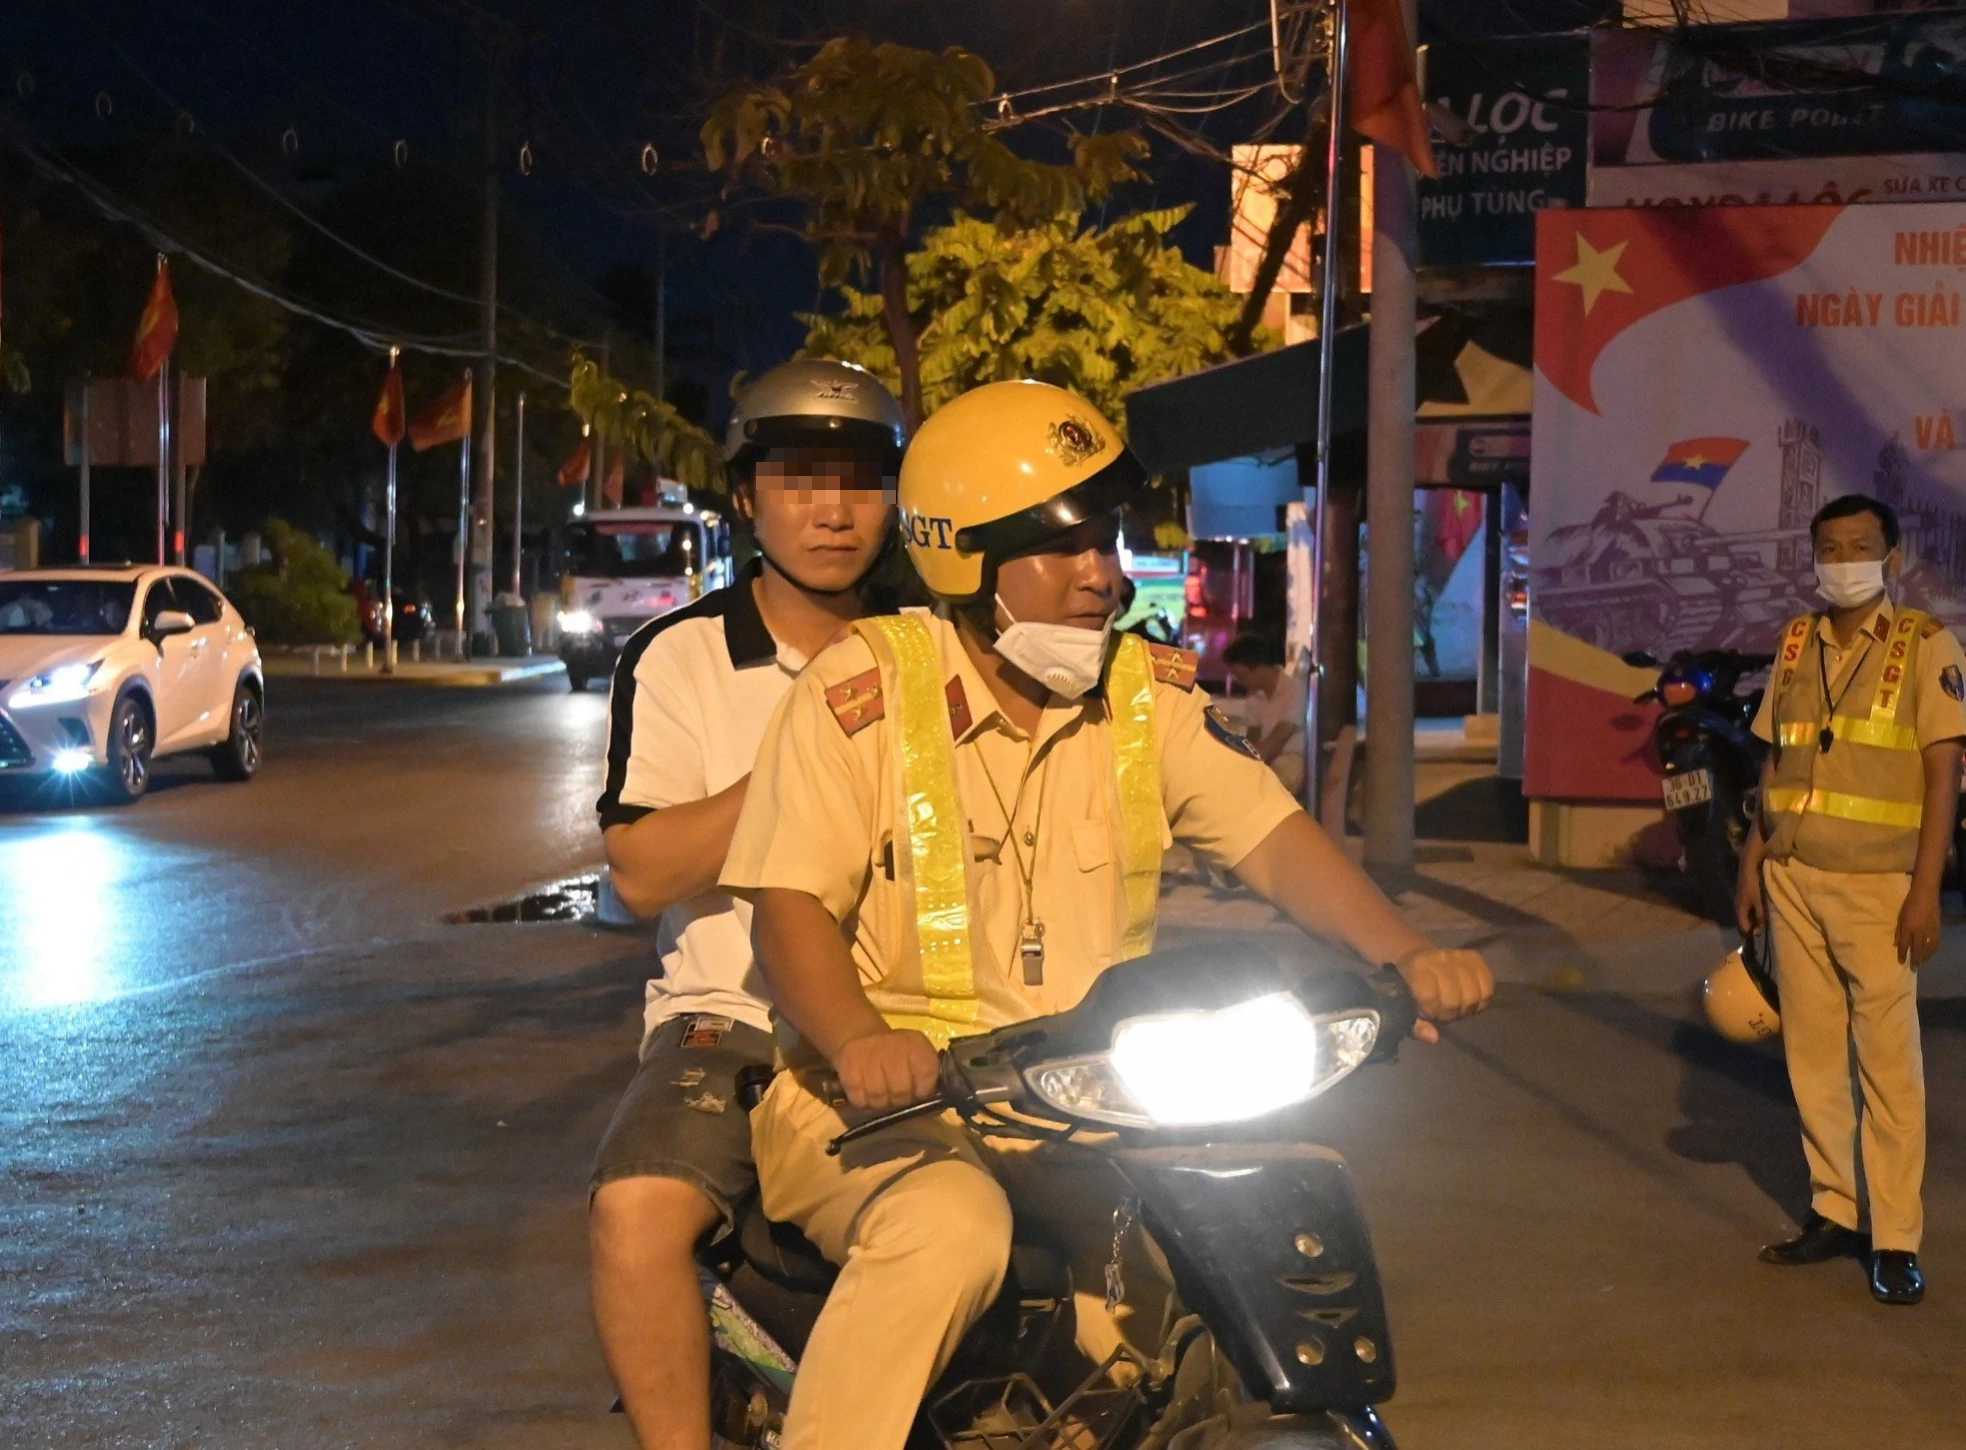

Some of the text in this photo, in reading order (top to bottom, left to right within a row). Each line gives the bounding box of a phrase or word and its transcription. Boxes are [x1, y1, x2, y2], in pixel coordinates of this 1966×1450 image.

[1706, 109, 1775, 132] BIKE
[1471, 142, 1572, 176] NGHIỆP
[1421, 186, 1545, 222] PHỤ TÙNG
[1796, 280, 1961, 328] NGÀY GIẢI
[1914, 407, 1956, 450] VÀ
[1879, 617, 1914, 709] CSGT
